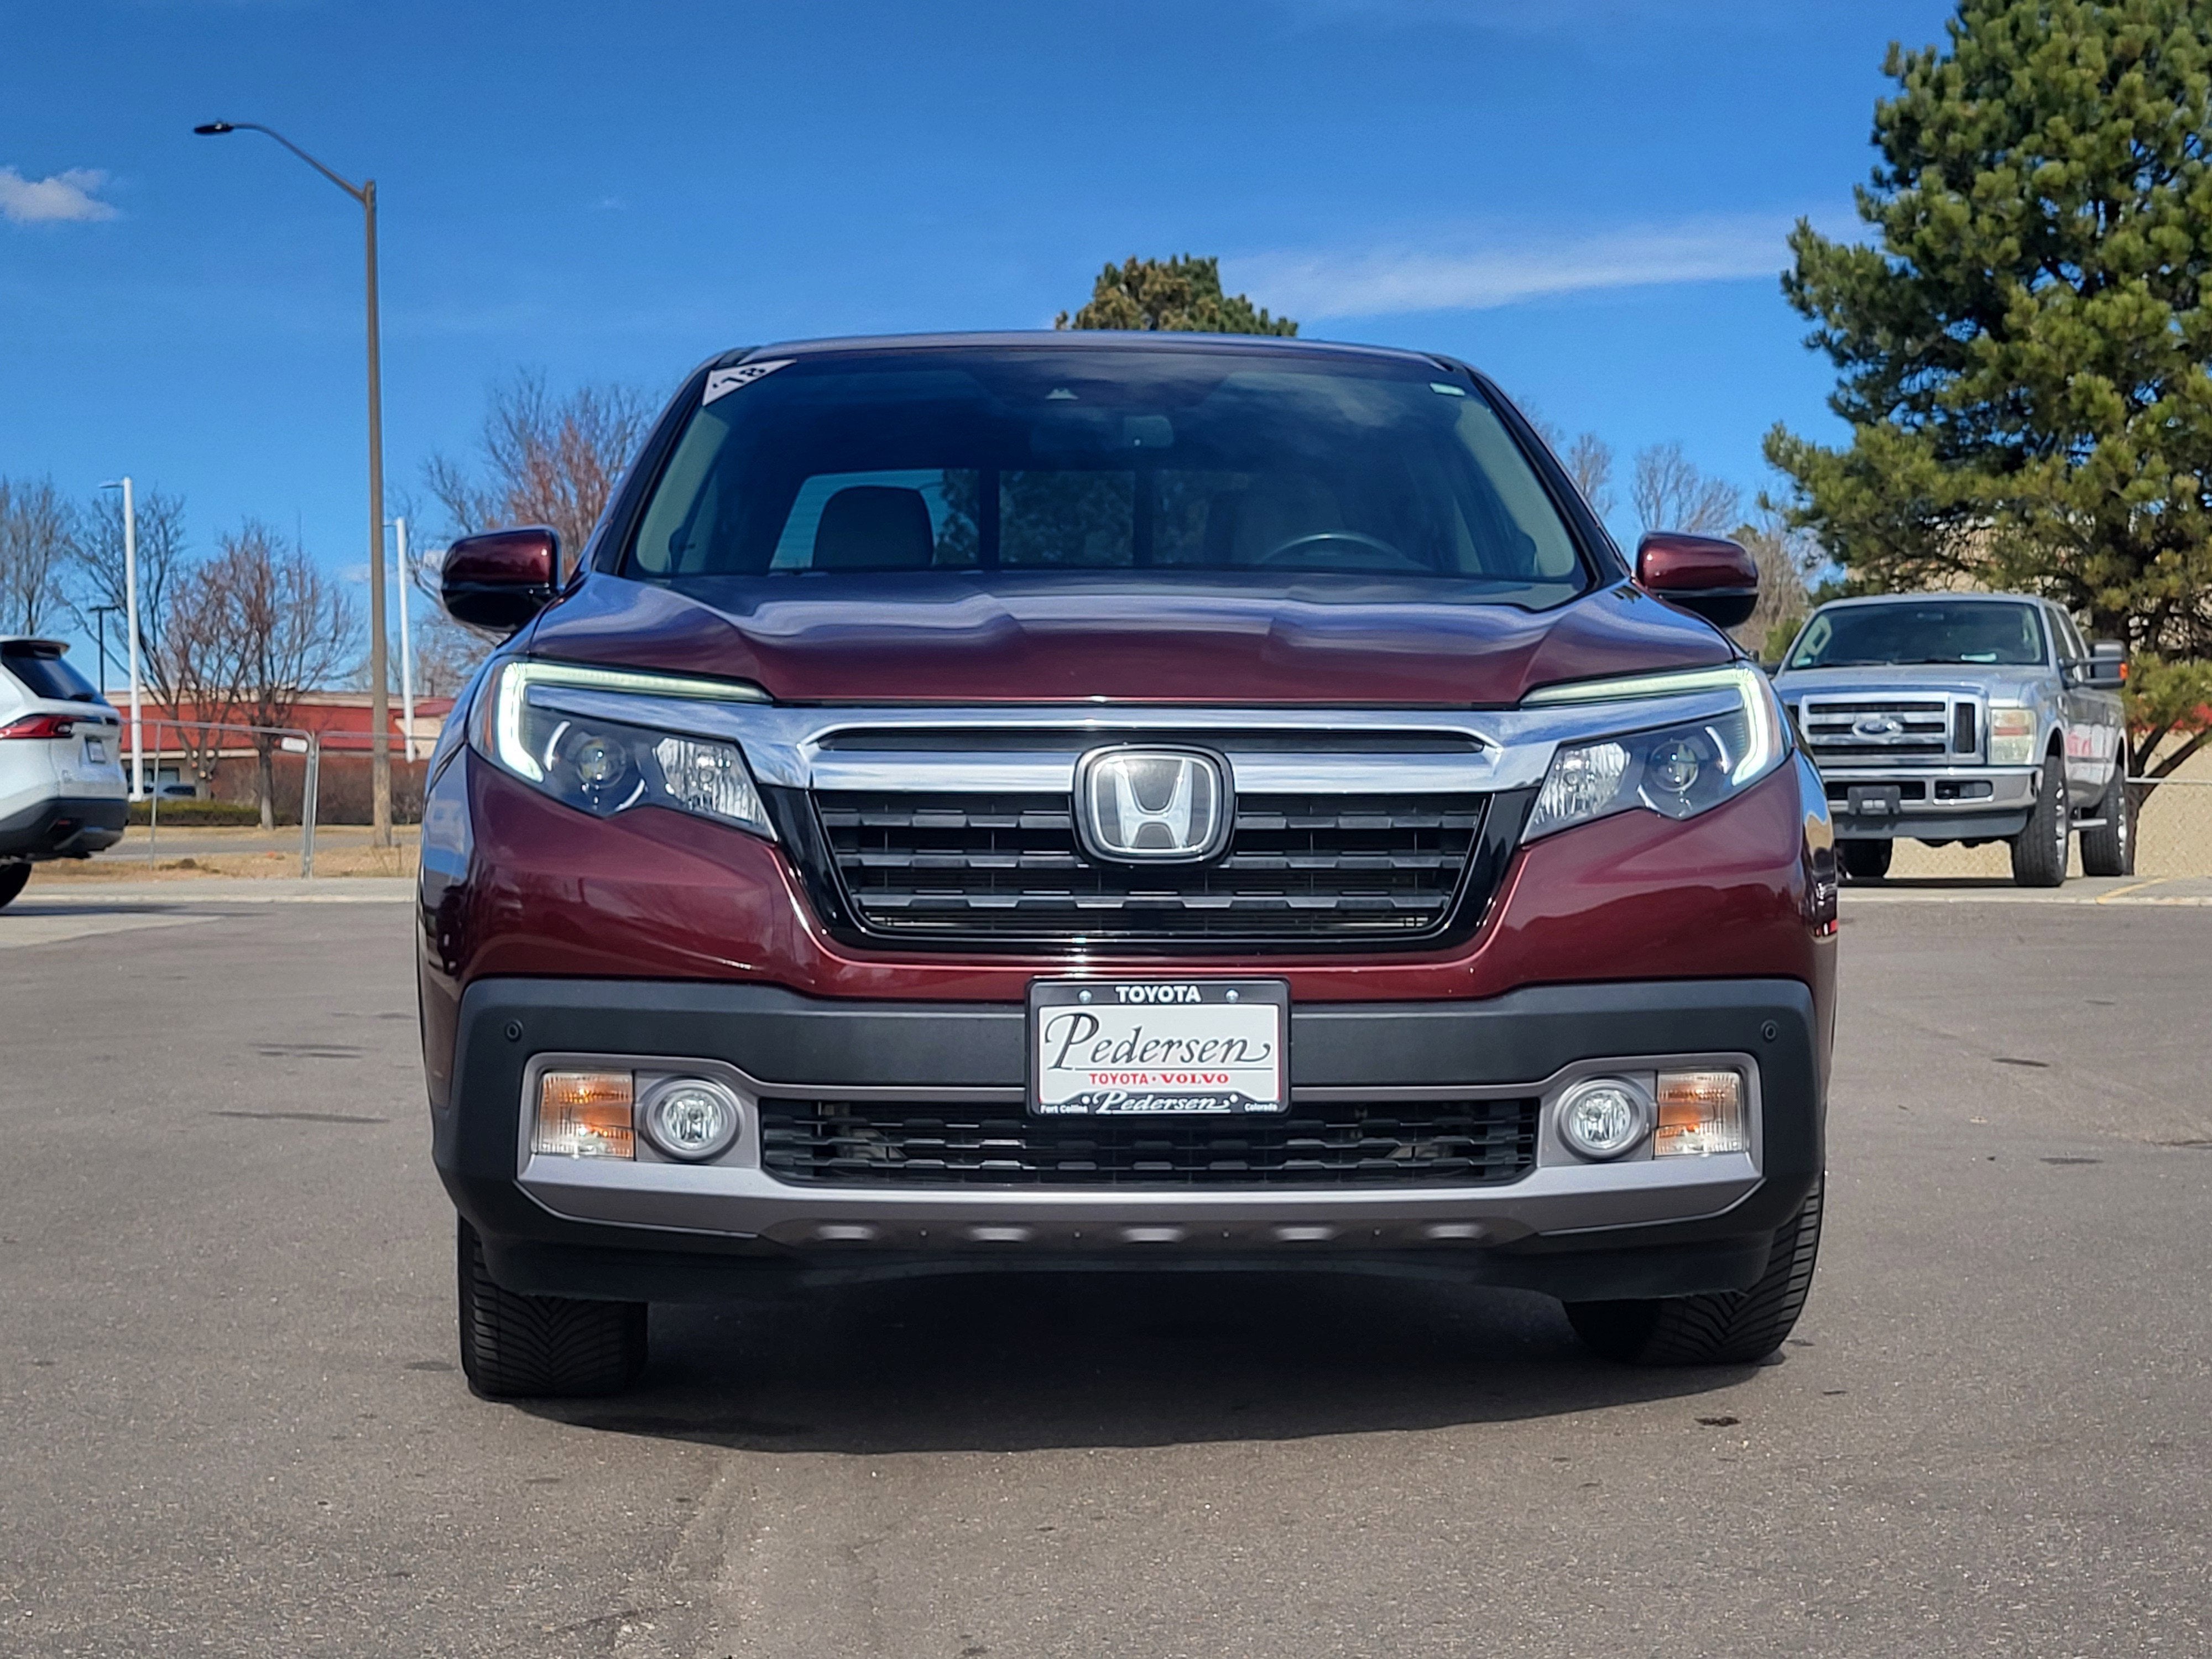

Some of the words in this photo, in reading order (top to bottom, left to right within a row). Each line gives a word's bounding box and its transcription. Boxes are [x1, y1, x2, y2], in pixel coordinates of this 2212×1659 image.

[1115, 985, 1202, 1003] TOYOTA
[1045, 1012, 1271, 1071] Pedersen
[1089, 1073, 1149, 1084] TOYOTA
[1161, 1073, 1229, 1084] VOLVO
[1092, 1090, 1231, 1114] Pedersen
